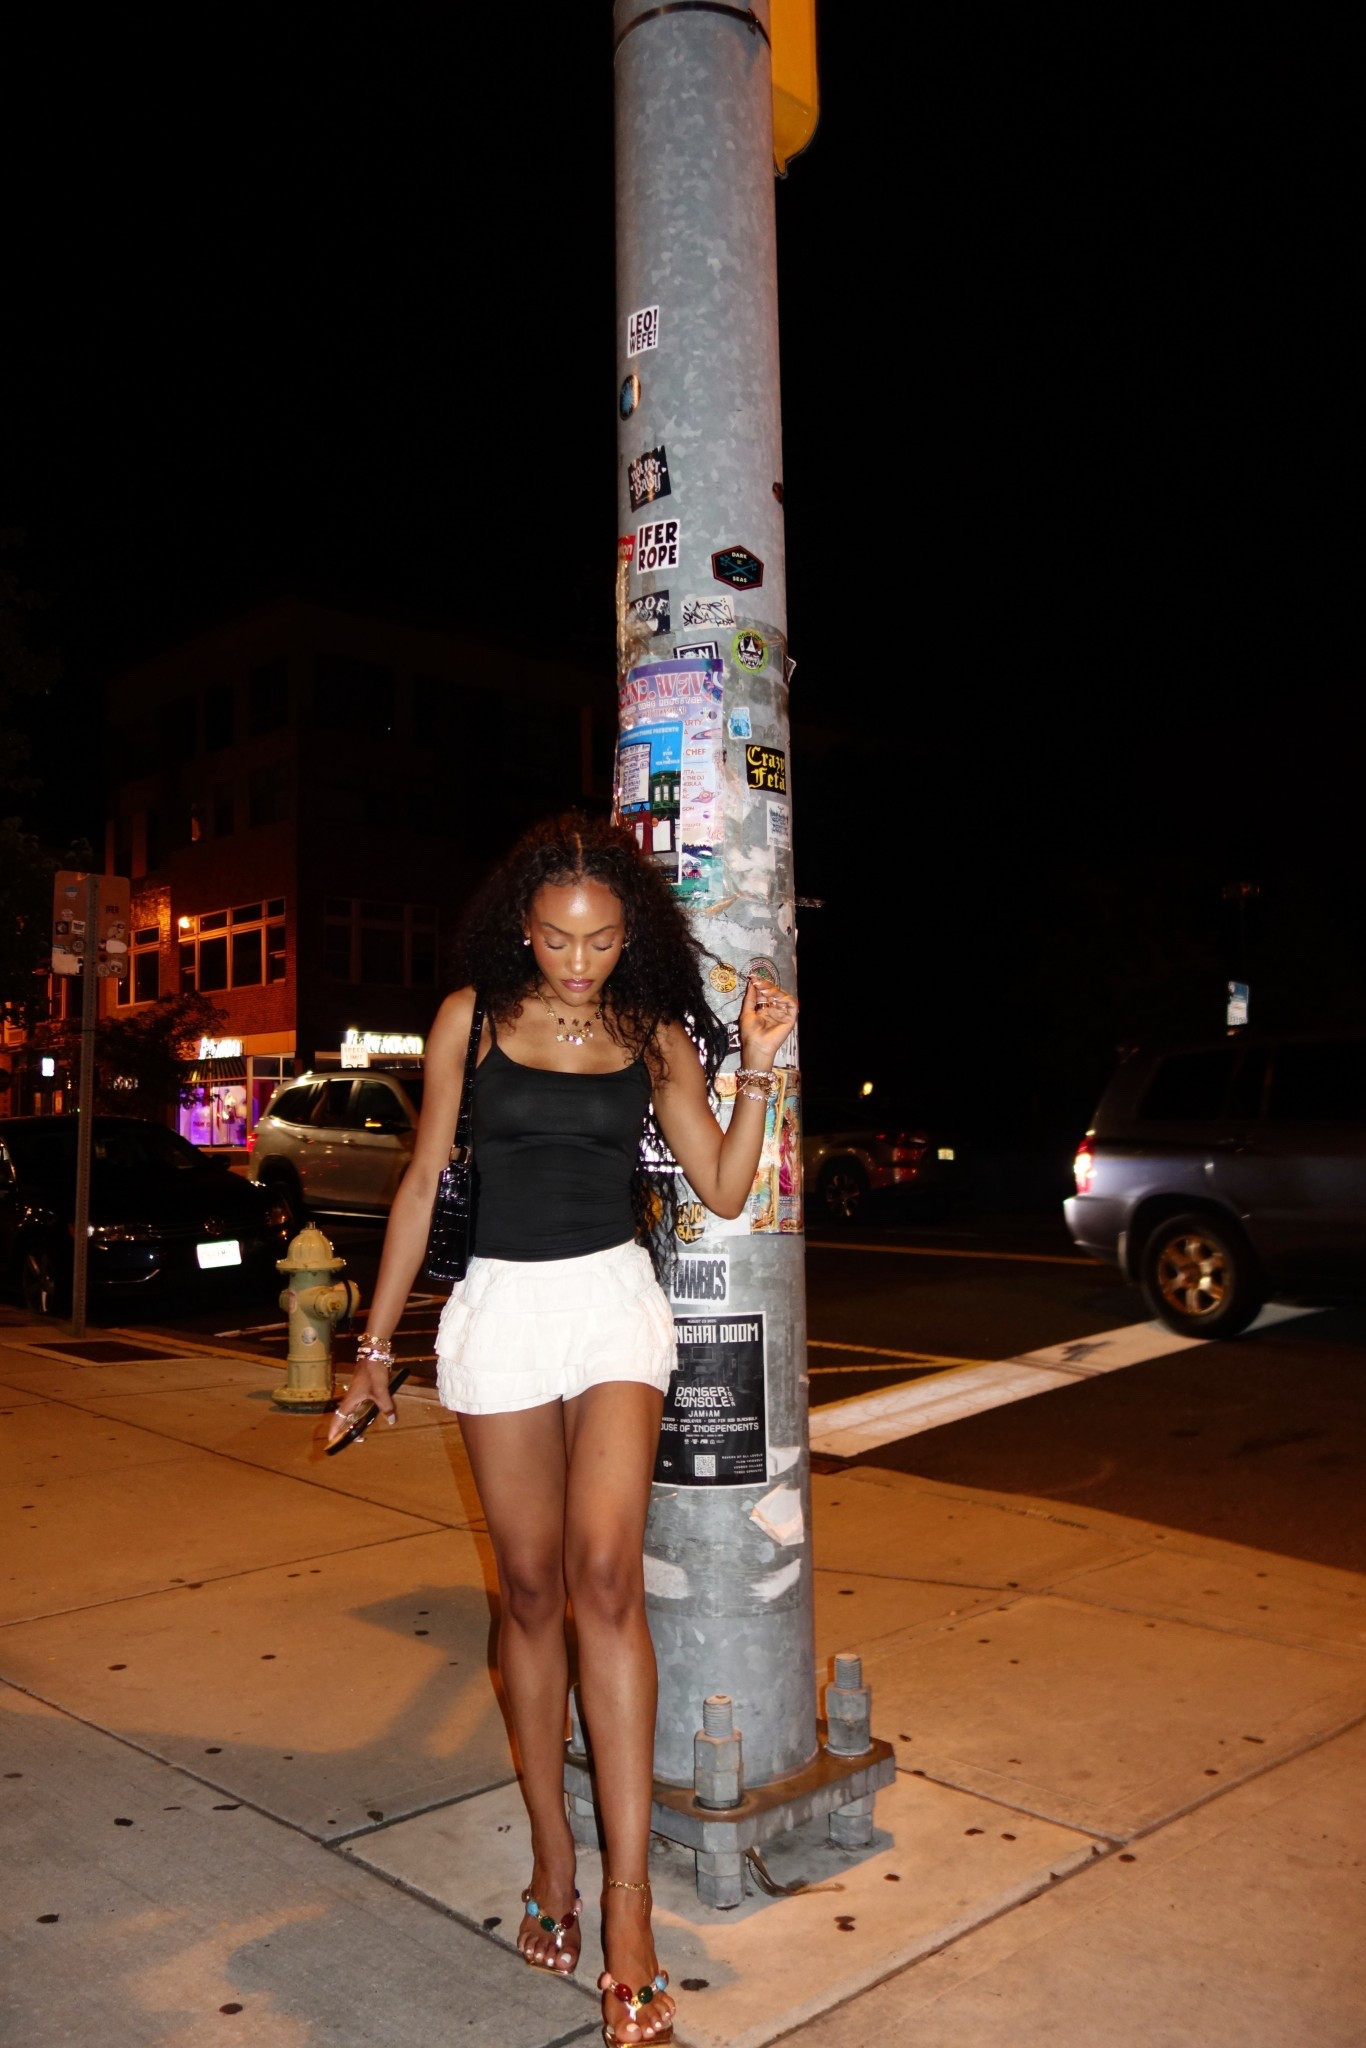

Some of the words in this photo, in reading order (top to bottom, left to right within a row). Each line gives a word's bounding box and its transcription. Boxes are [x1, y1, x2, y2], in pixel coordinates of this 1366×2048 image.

[630, 309, 657, 338] LEO!
[630, 330, 656, 354] WEFE!
[639, 521, 678, 549] IFER
[638, 544, 677, 571] ROPE
[685, 748, 707, 756] CHEF
[747, 746, 785, 775] Crazy
[748, 767, 785, 791] Feta
[719, 1323, 759, 1343] DOOM
[674, 1396, 731, 1408] CONSOLE
[676, 1386, 727, 1397] DANGER
[680, 1424, 690, 1433] OF
[692, 1422, 759, 1433] INDEPENDENTS
[662, 1460, 672, 1468] 18+
